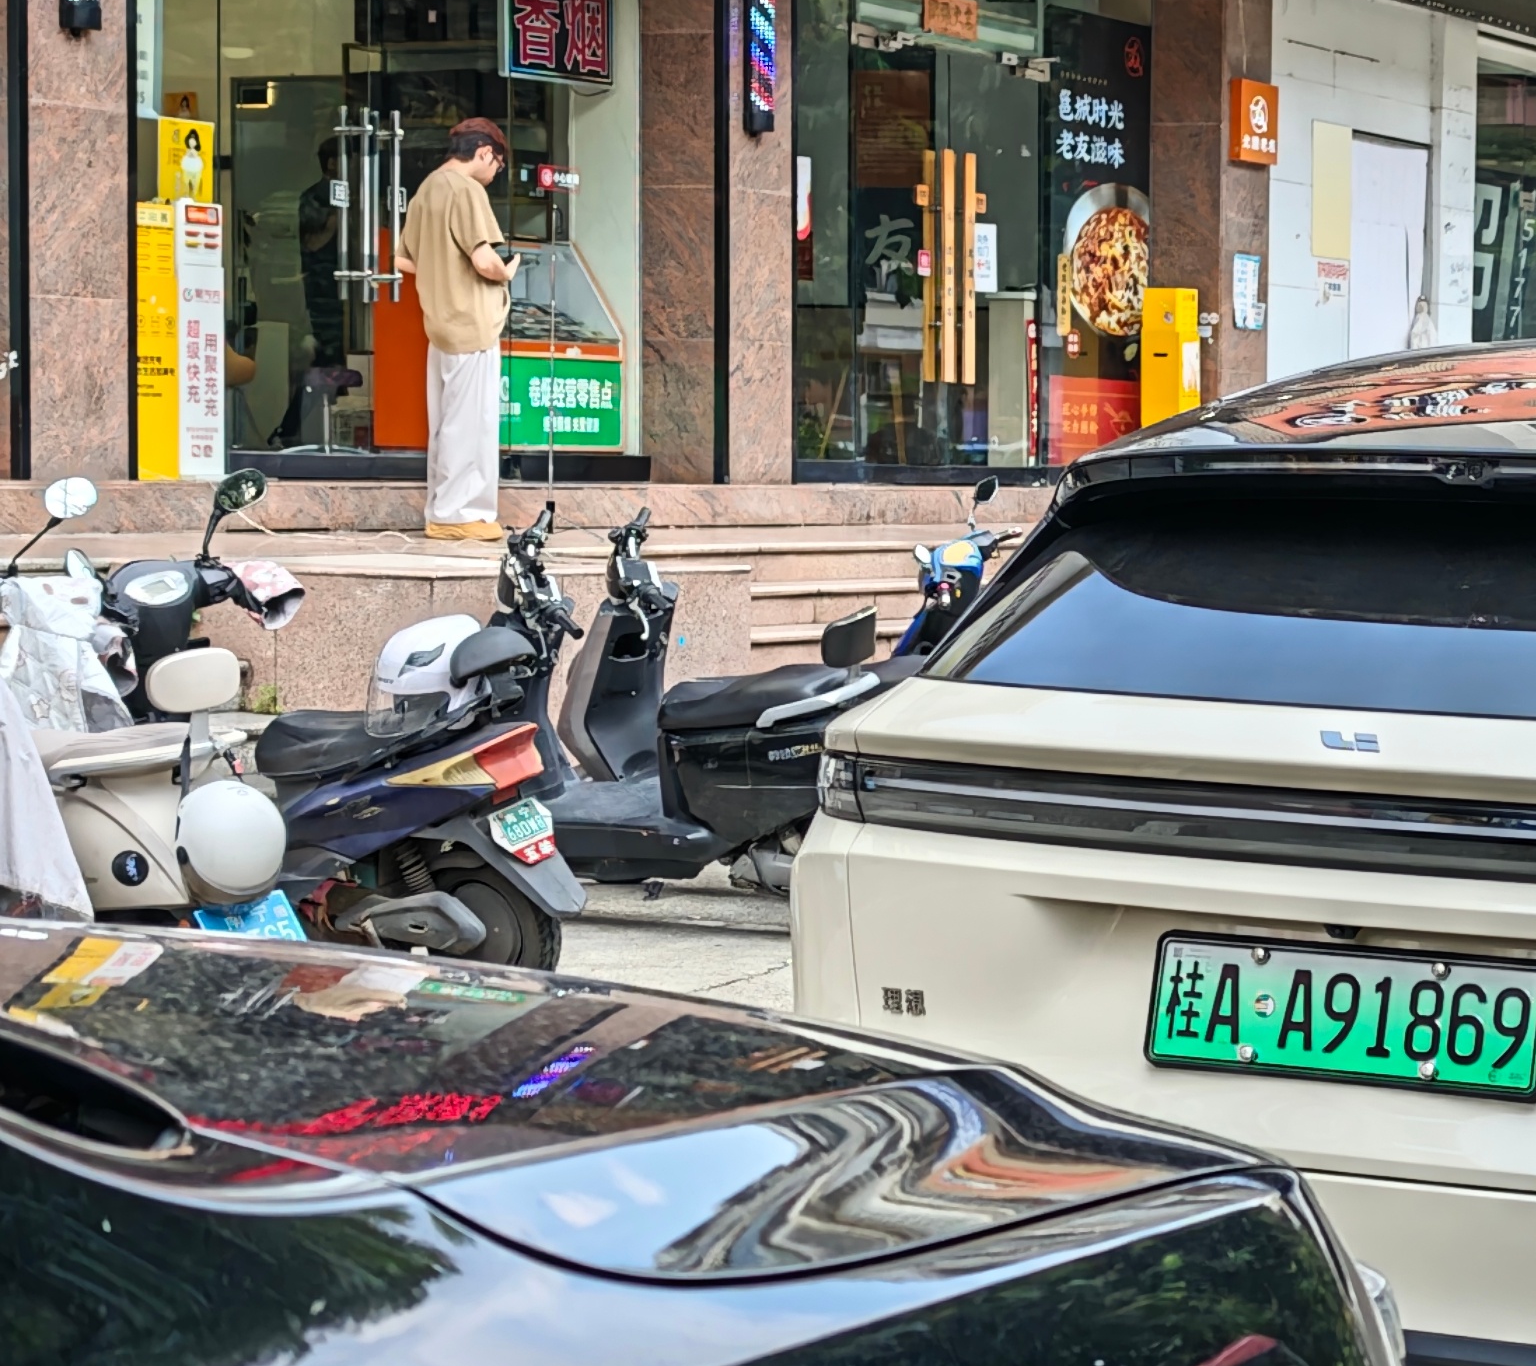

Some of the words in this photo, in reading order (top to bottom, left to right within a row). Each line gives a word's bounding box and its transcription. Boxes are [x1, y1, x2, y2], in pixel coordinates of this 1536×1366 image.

[1058, 88, 1126, 130] 邕城时光
[1056, 128, 1126, 170] 老友滋味
